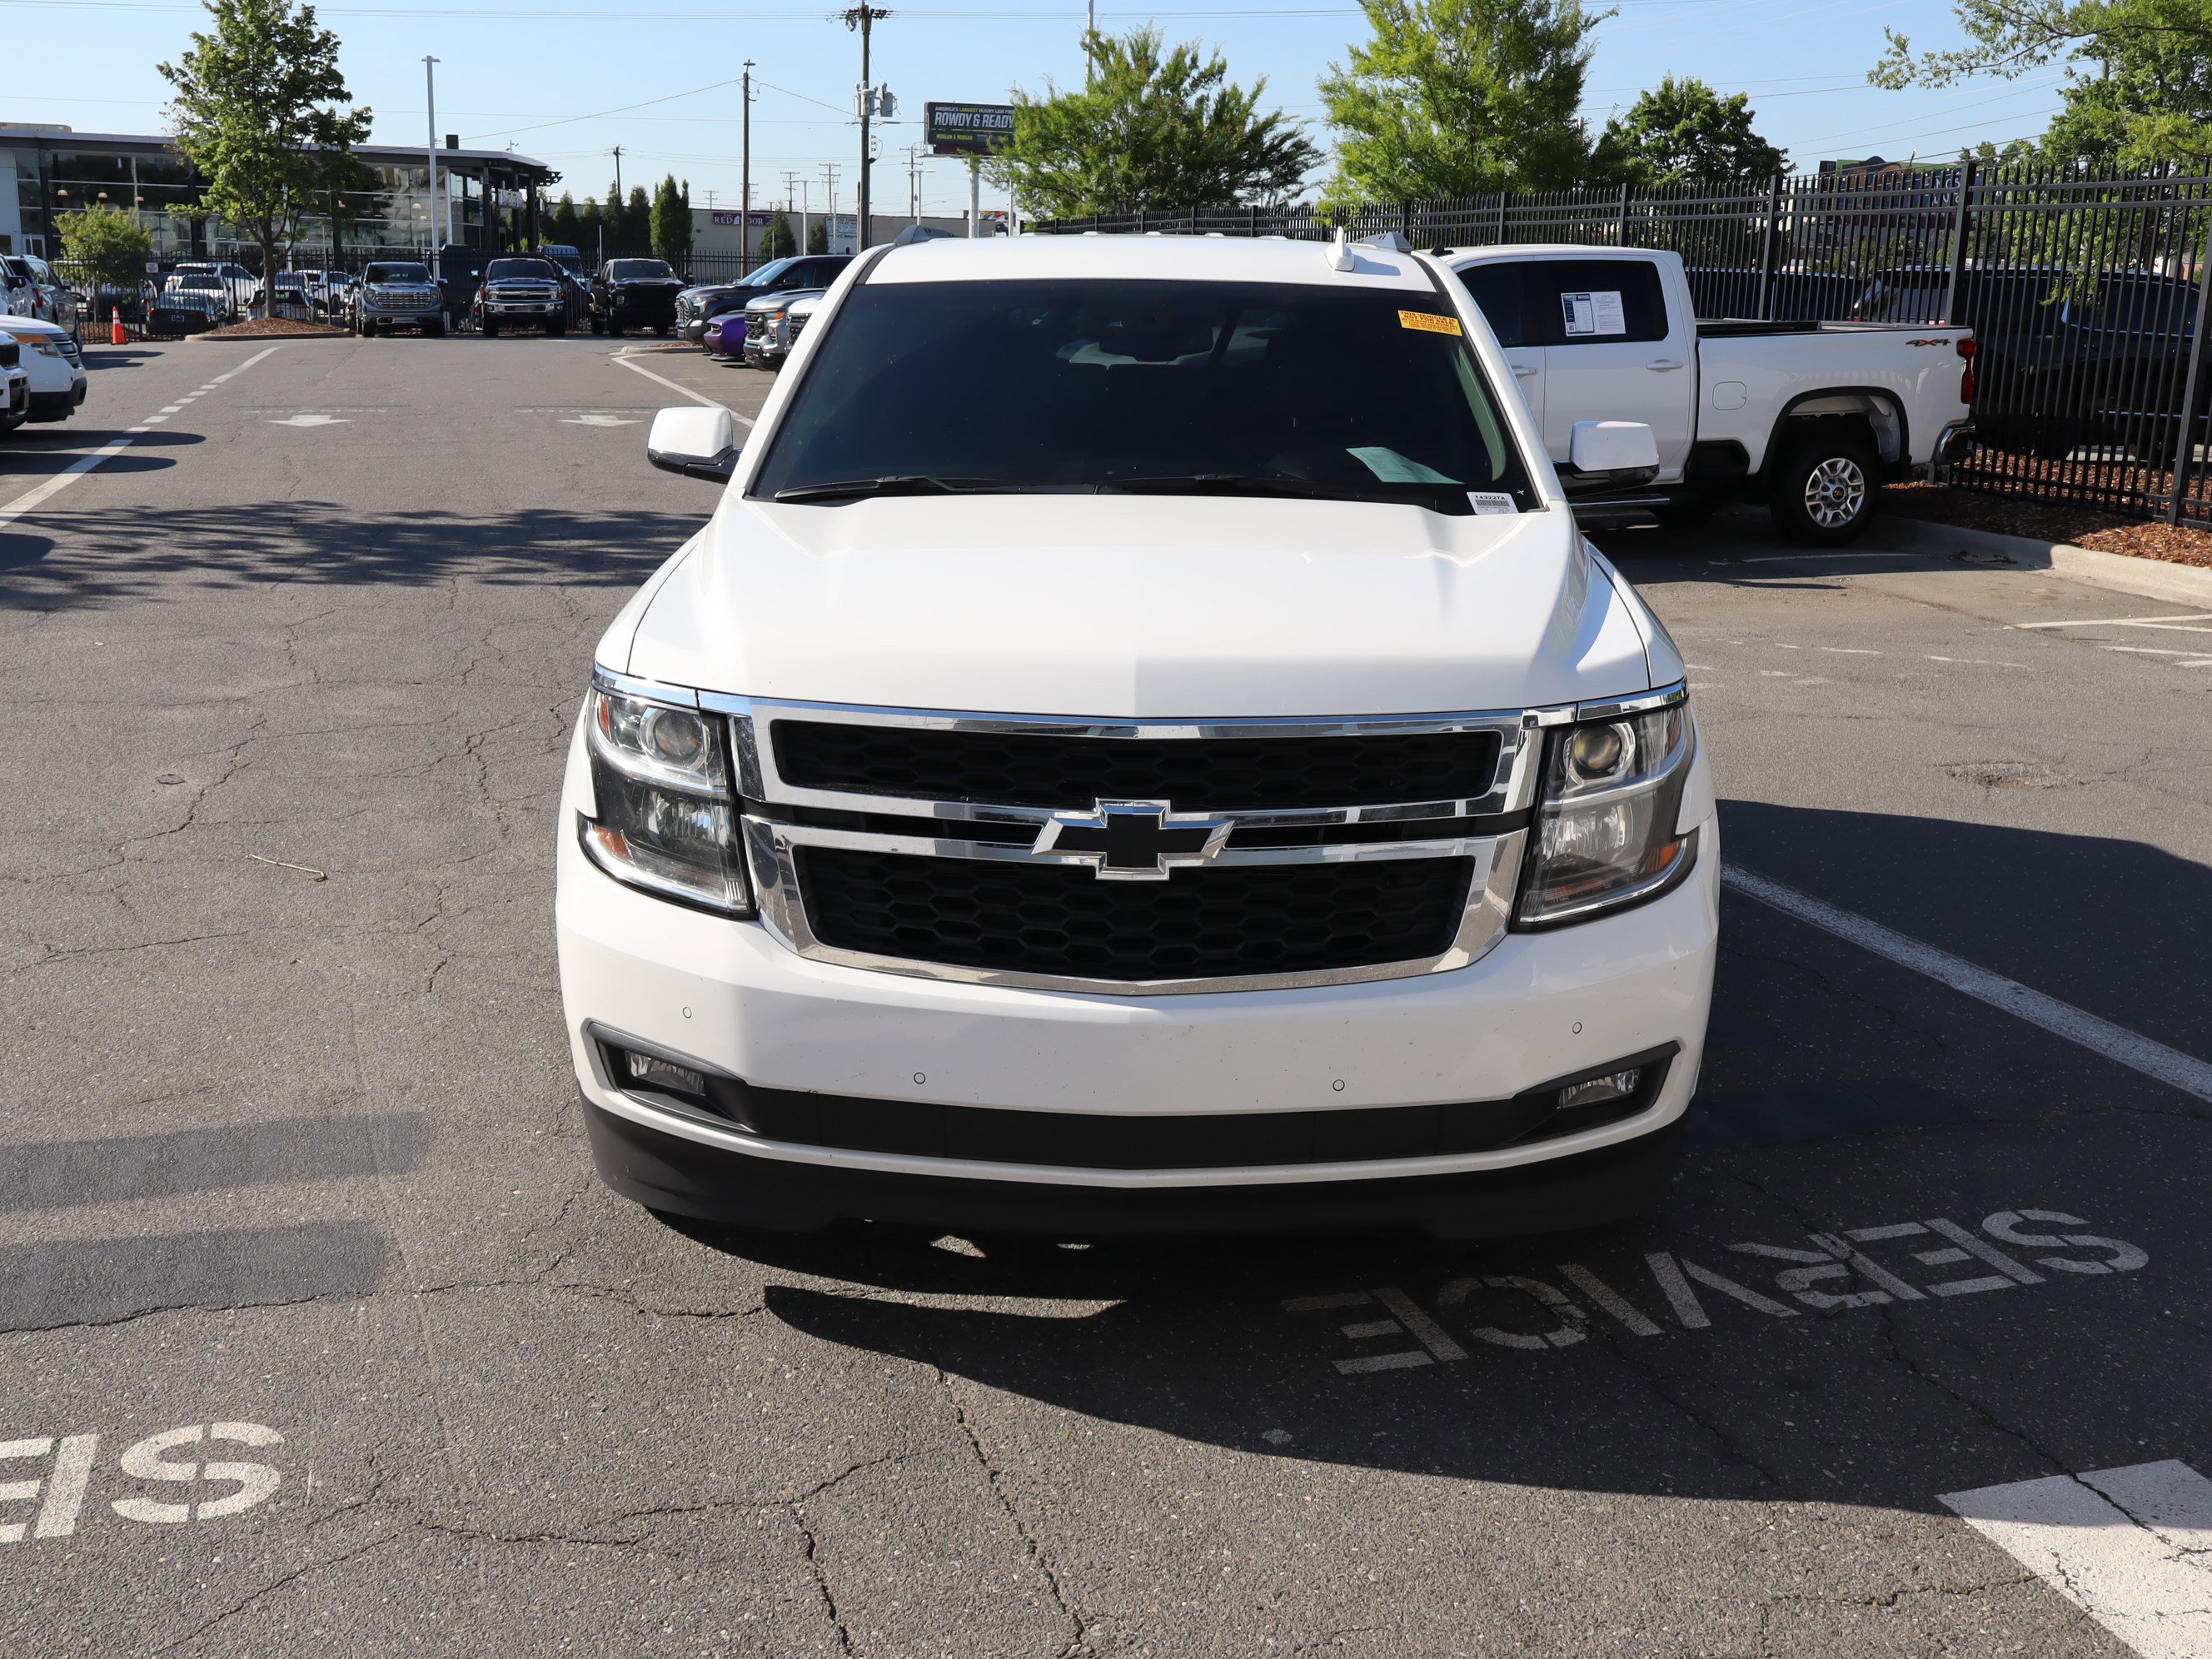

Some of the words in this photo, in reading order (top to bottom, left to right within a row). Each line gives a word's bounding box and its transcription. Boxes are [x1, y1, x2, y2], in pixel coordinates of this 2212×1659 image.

[934, 112, 972, 127] ROWDY
[973, 113, 980, 127] &
[982, 114, 1014, 128] READY
[1281, 1208, 2150, 1376] SERVICE
